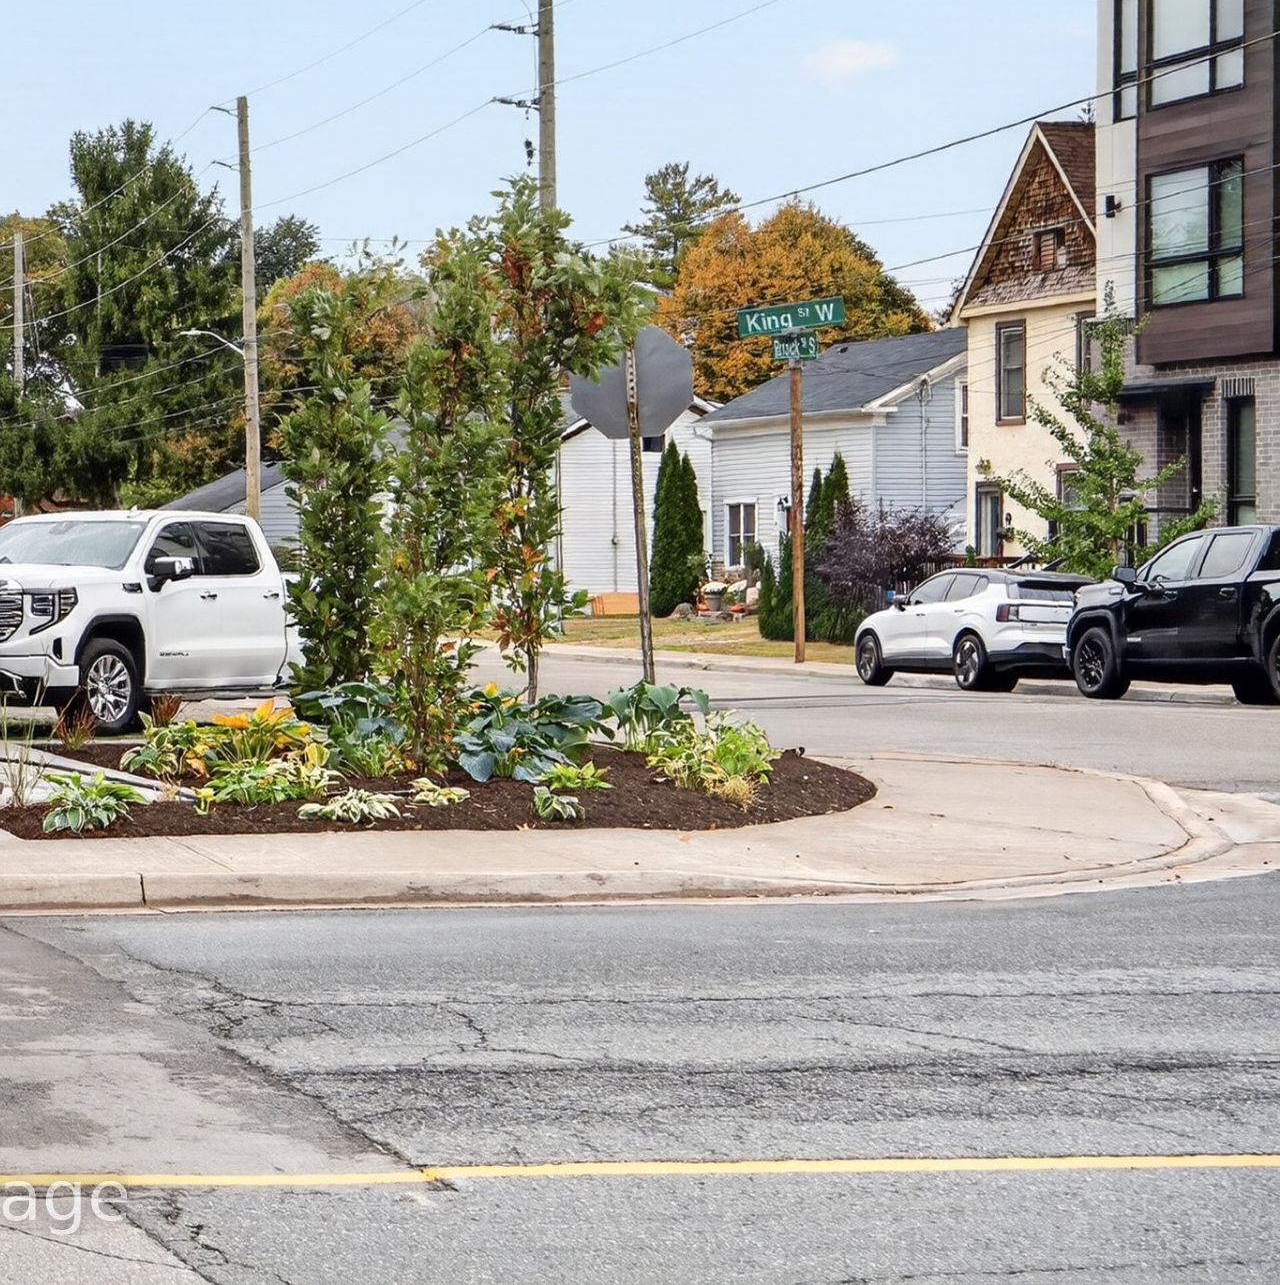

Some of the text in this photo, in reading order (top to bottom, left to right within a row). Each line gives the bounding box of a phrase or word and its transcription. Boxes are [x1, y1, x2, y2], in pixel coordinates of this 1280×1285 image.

[745, 303, 834, 332] King St W
[808, 336, 816, 354] S
